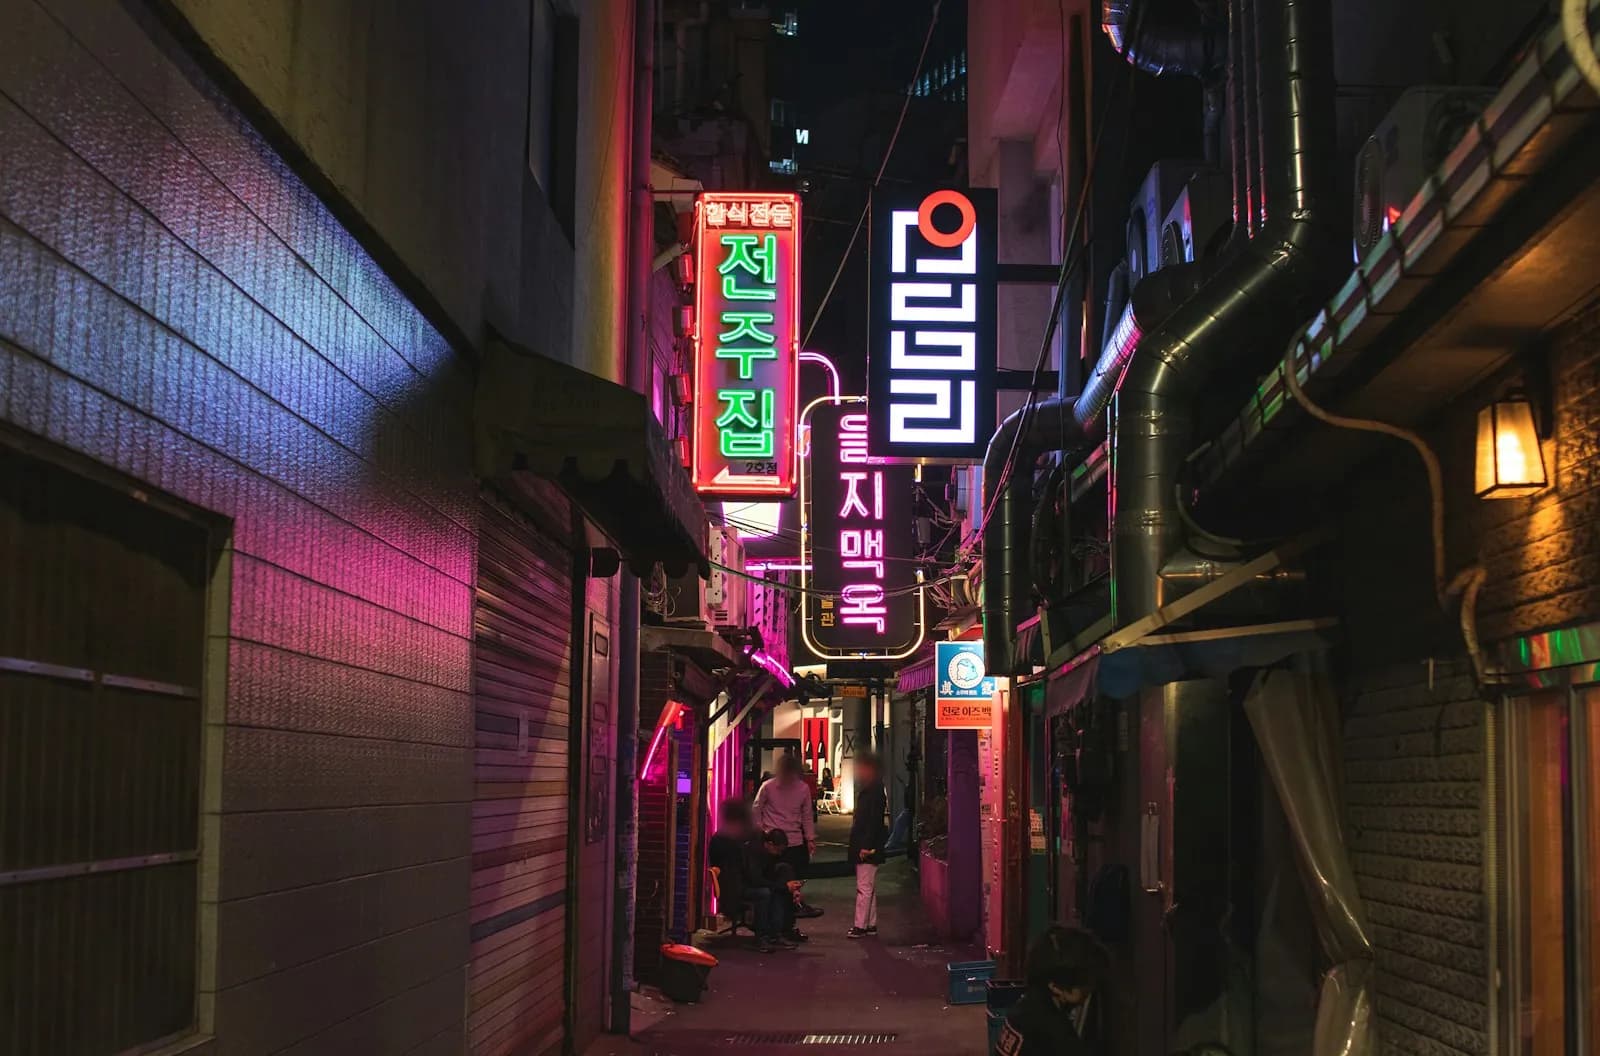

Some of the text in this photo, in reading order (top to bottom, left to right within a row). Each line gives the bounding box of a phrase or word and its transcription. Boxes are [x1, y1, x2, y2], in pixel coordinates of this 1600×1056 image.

[706, 202, 792, 227] 한식전문
[715, 234, 777, 458] 전주집
[746, 462, 777, 474] 2호점
[942, 706, 960, 717] 진로
[962, 706, 981, 717] 이즈
